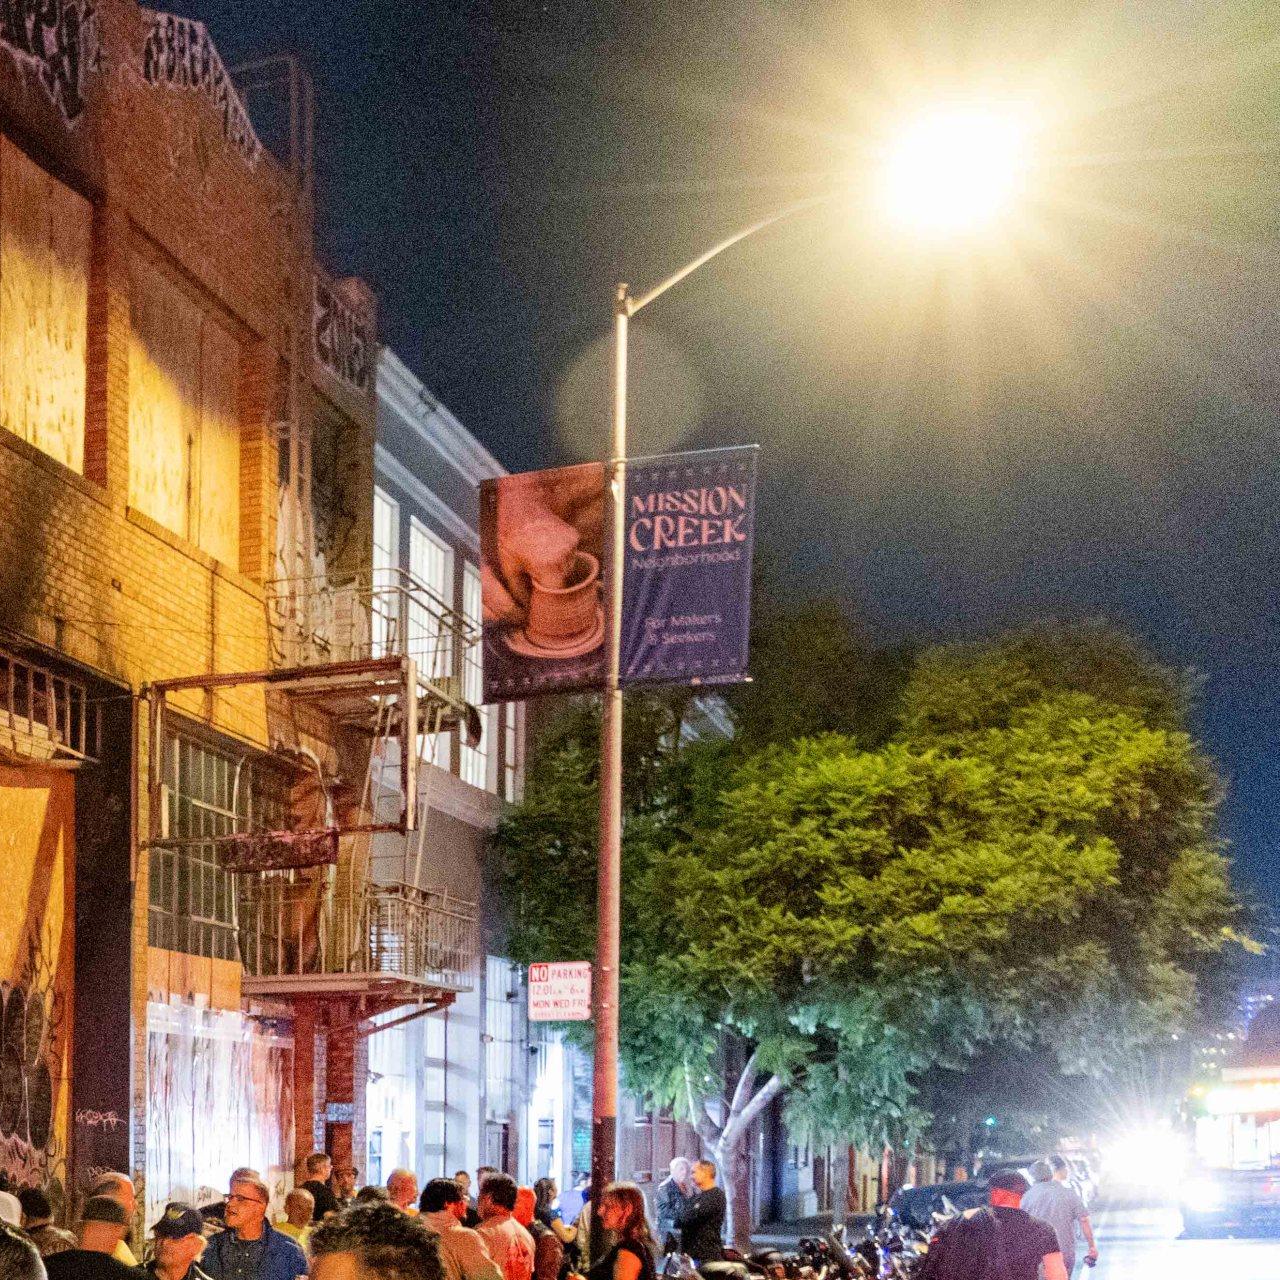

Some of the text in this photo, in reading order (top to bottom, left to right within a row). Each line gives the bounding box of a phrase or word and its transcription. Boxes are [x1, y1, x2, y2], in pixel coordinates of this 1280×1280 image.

[632, 487, 746, 518] MISSION
[630, 513, 747, 551] CREEK
[531, 966, 548, 981] NO
